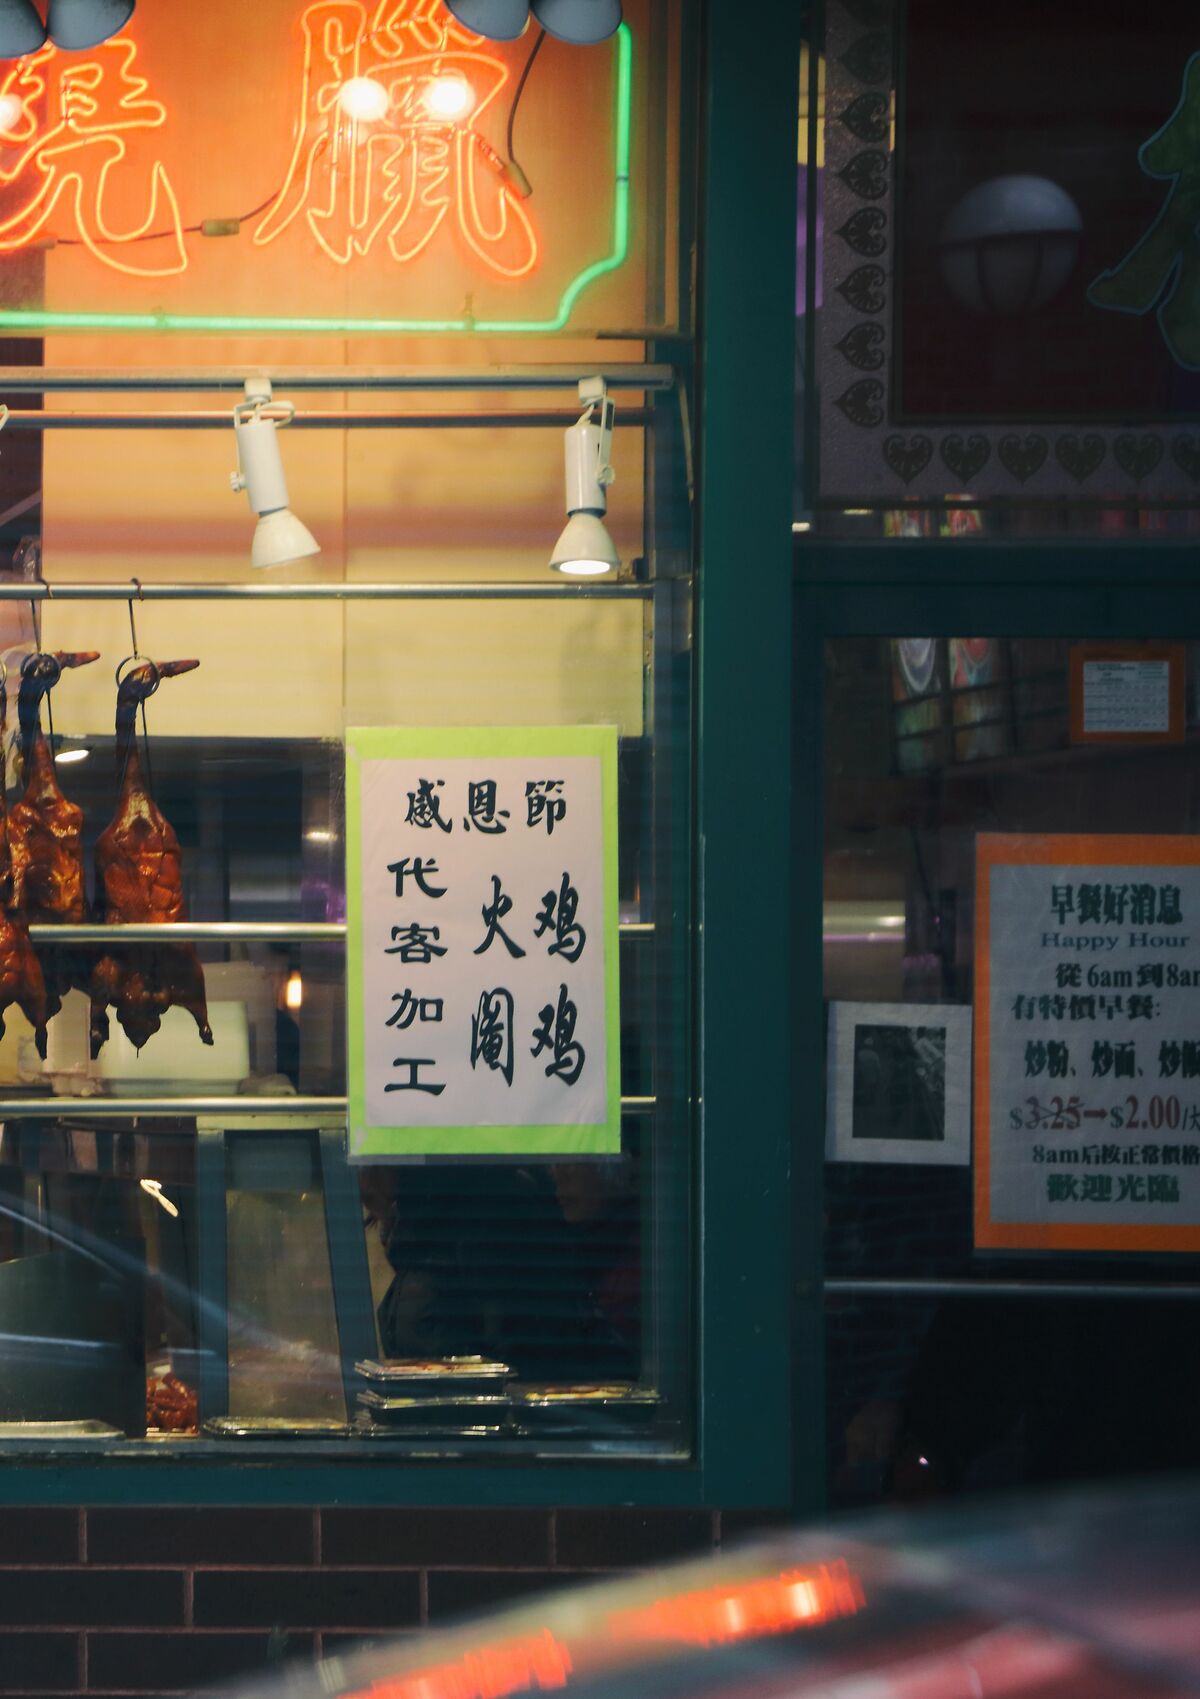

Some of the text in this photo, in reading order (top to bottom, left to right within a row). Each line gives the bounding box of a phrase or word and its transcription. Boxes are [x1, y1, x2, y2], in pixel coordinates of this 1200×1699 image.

[404, 778, 568, 836] 感恩節
[1050, 883, 1184, 925] 早餐好消息
[1041, 932, 1191, 951] Happy Hour
[383, 857, 449, 1097] 代客加工
[1046, 1173, 1181, 1205] 歡迎光臨
